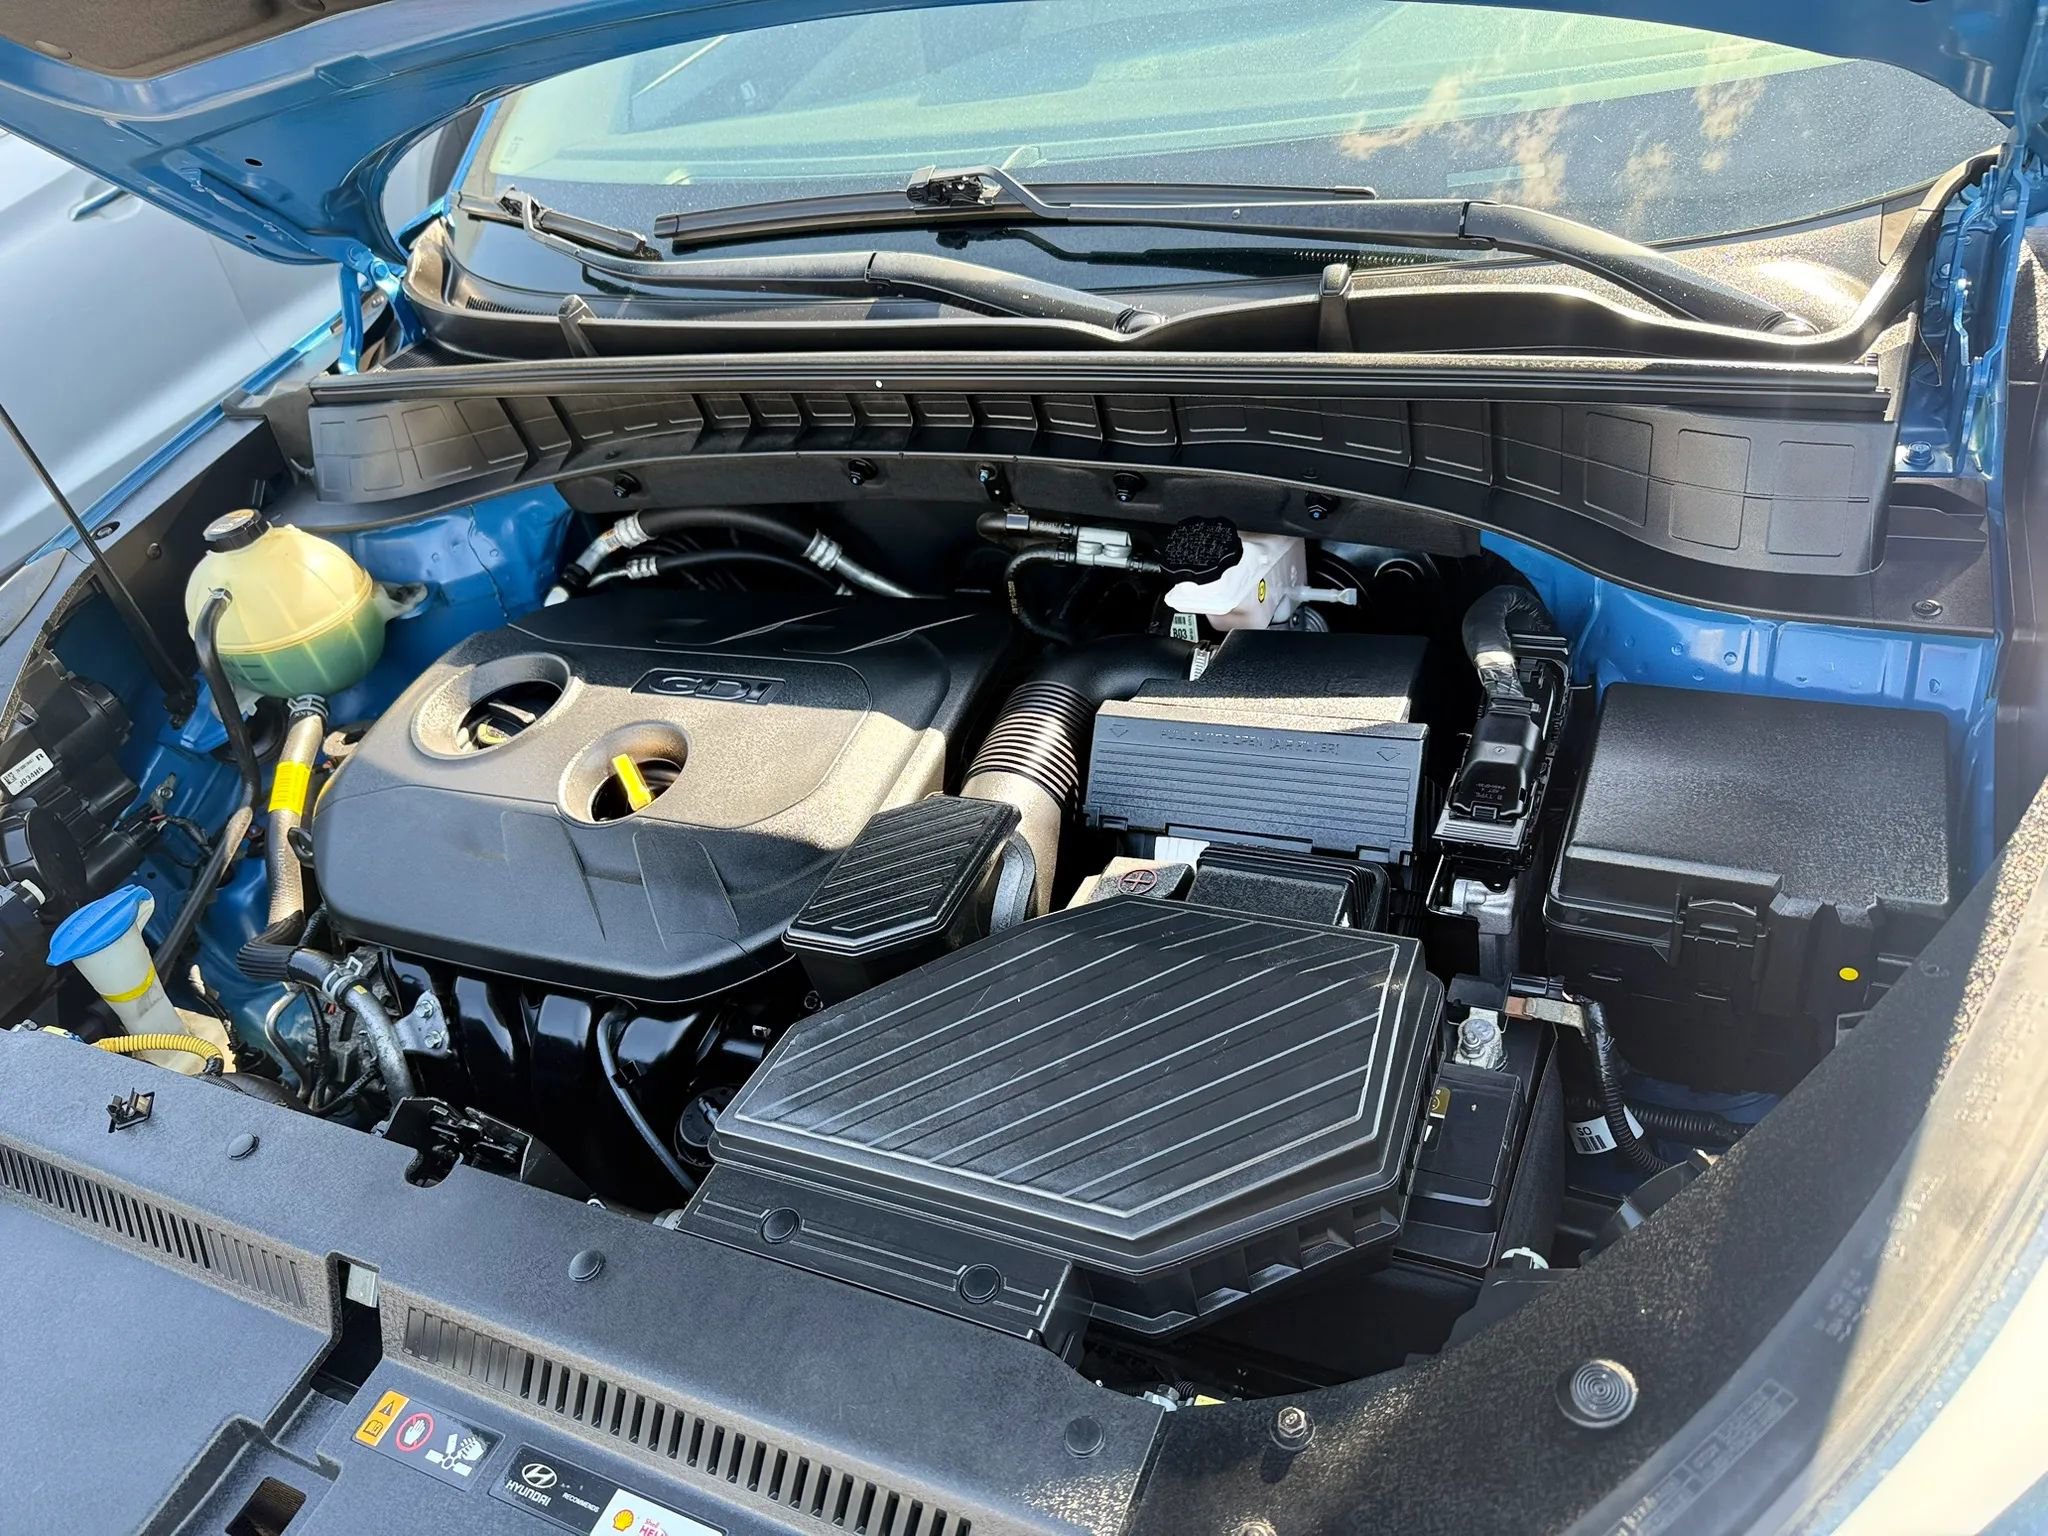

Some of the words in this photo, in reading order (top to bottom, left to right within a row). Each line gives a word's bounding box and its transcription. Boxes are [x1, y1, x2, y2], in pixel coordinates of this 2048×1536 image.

[649, 677, 772, 703] GDI
[505, 1480, 552, 1506] HYUNDAI
[562, 1492, 600, 1513] RECOMMENDS
